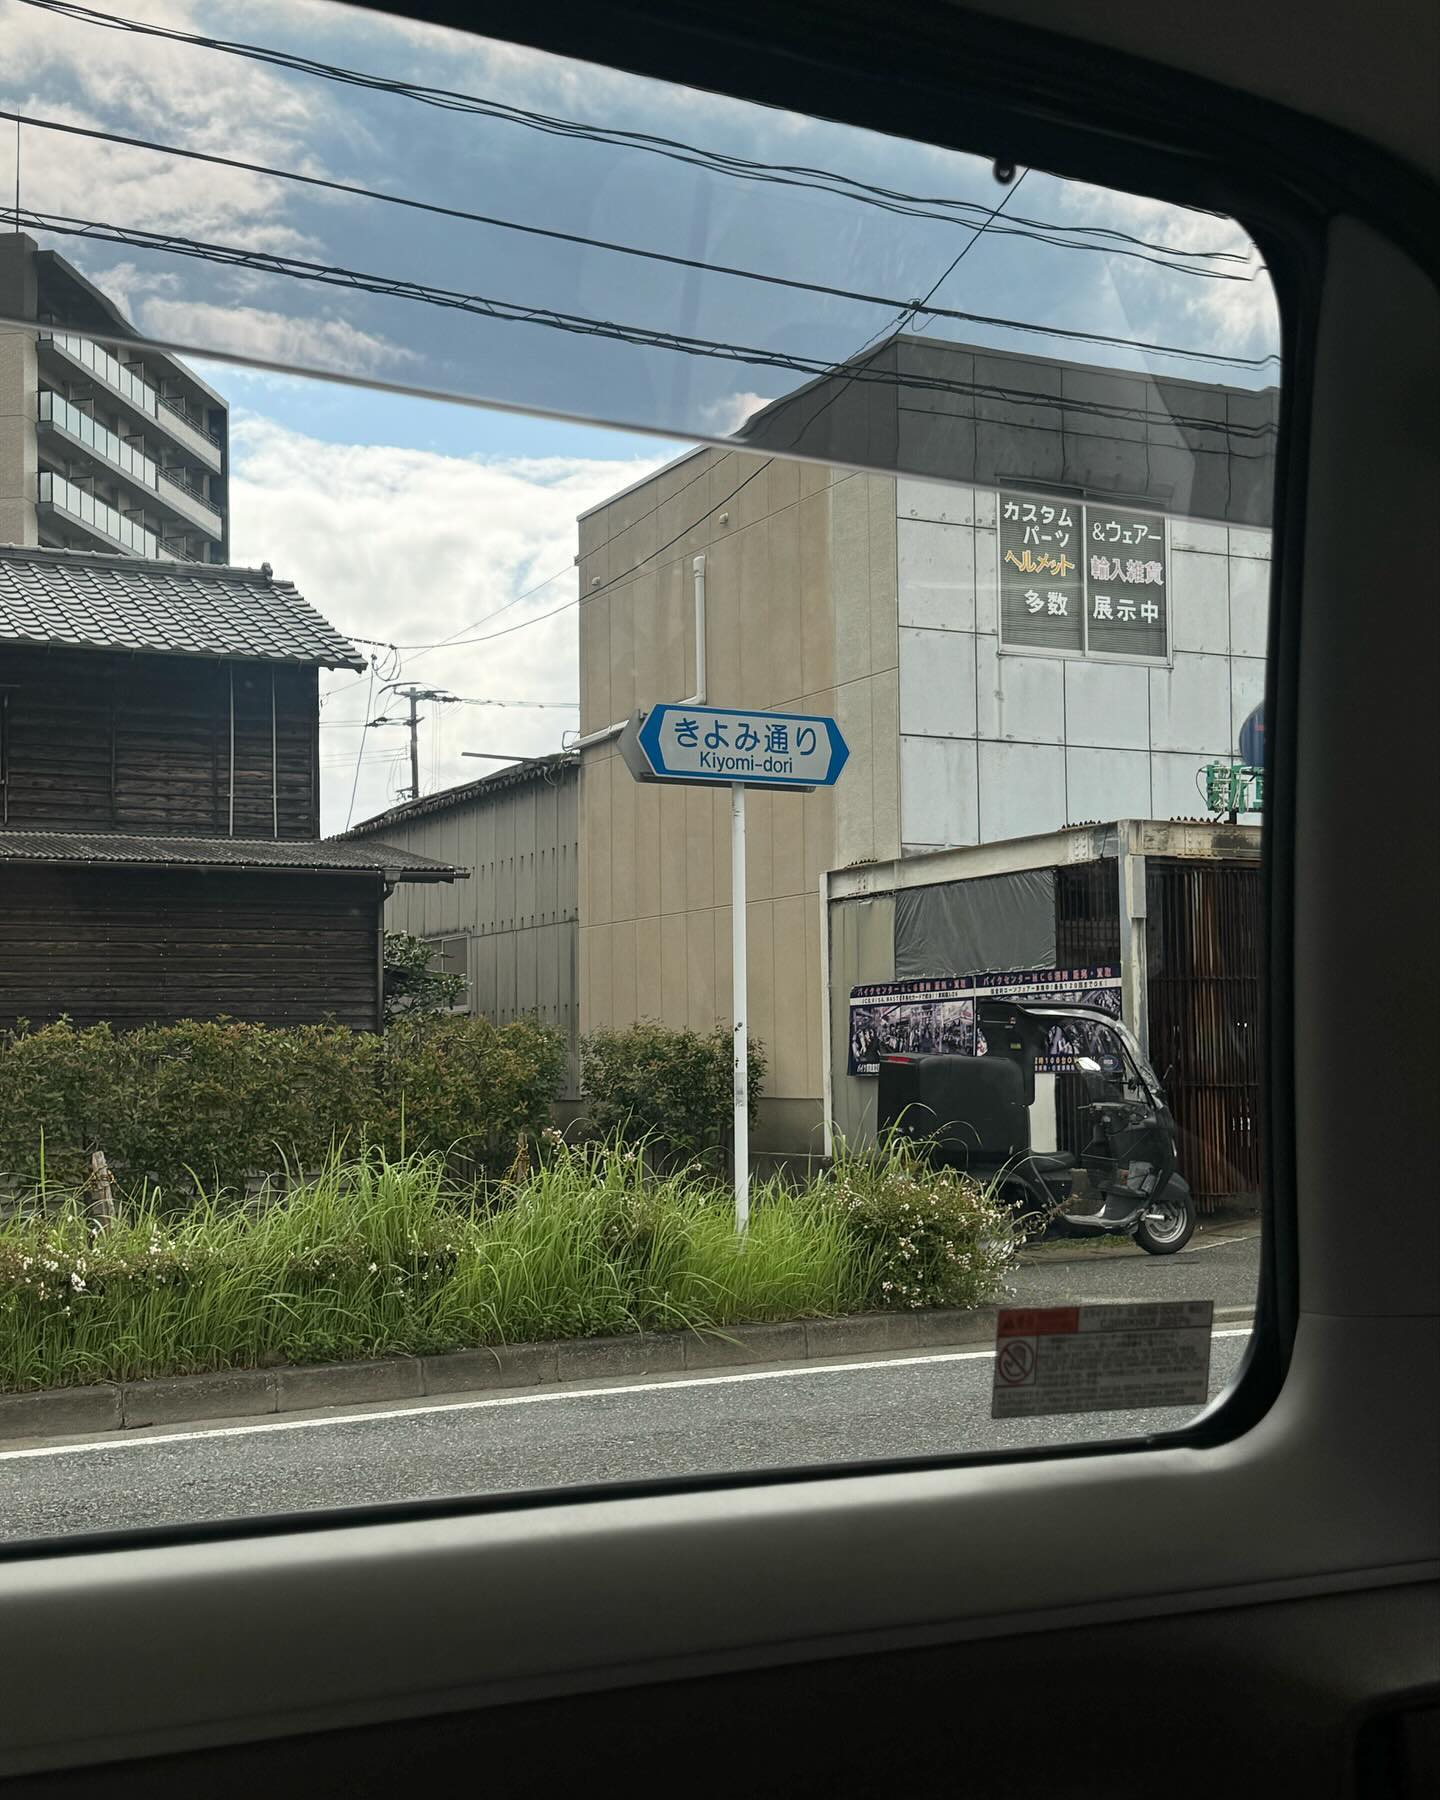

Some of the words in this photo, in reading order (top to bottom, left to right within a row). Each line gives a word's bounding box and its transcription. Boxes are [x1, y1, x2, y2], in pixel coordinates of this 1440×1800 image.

[1004, 501, 1073, 527] カスタム
[1023, 525, 1070, 547] パーツ
[1092, 521, 1161, 545] &ウェアー
[1004, 550, 1075, 577] ヘルメット
[1091, 555, 1164, 585] 輸入雑貨
[1024, 590, 1068, 616] 多数
[1093, 595, 1159, 623] 展示中
[674, 717, 817, 756] きよみ通り
[699, 751, 793, 774] Kiyomi-dori
